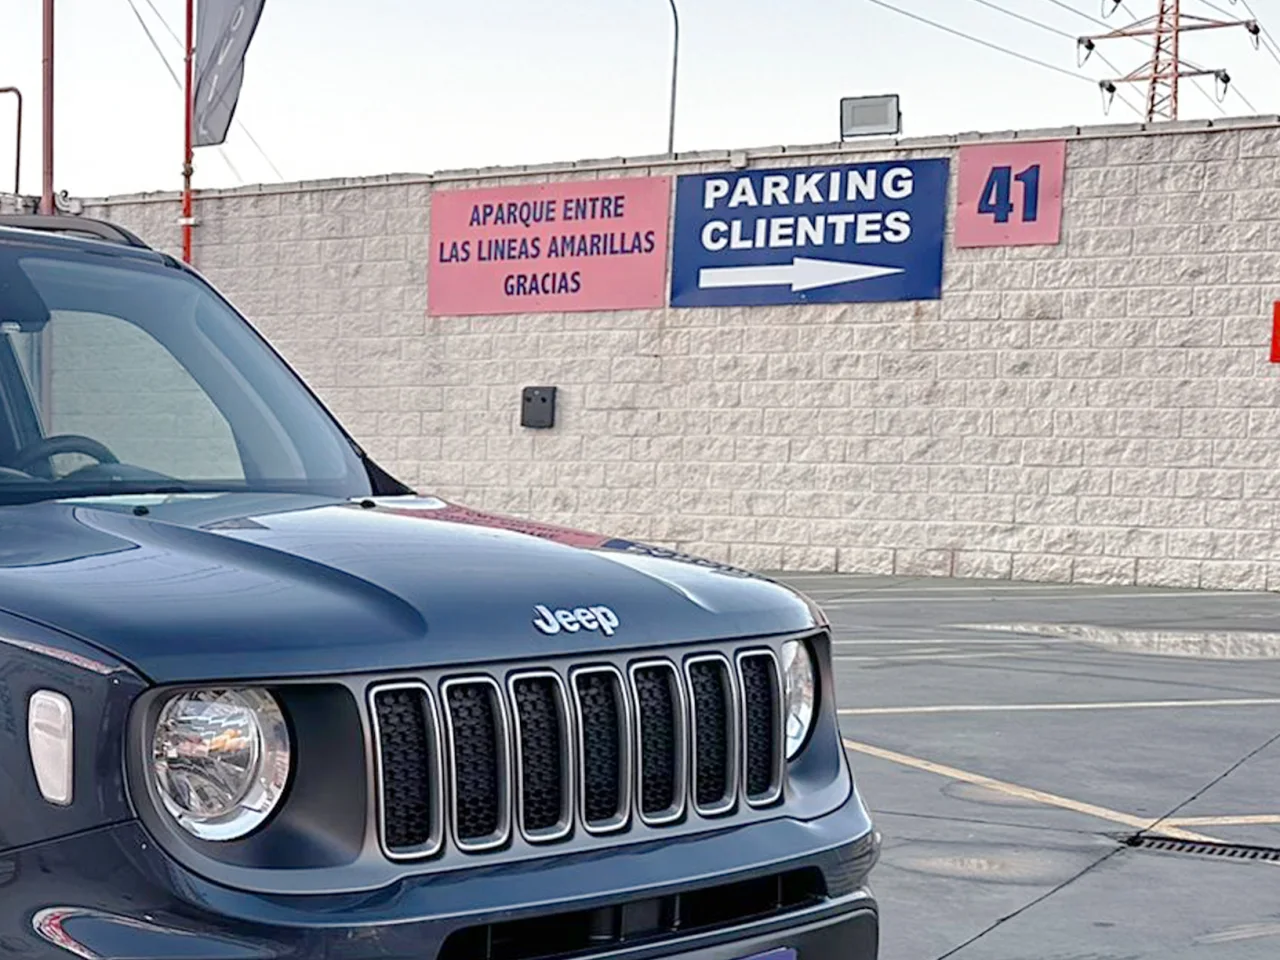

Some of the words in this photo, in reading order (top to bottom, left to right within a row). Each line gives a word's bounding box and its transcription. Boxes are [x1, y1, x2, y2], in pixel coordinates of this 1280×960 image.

[704, 167, 914, 209] PARKING
[977, 164, 1041, 223] 41
[469, 200, 556, 227] APARQUE
[563, 196, 625, 222] ENTRE
[439, 241, 470, 263] LAS
[478, 237, 541, 261] LINEAS
[548, 231, 655, 258] AMARILLAS
[701, 211, 912, 251] CLIENTES
[504, 272, 581, 296] GRACIAS
[532, 604, 619, 635] Jeep
